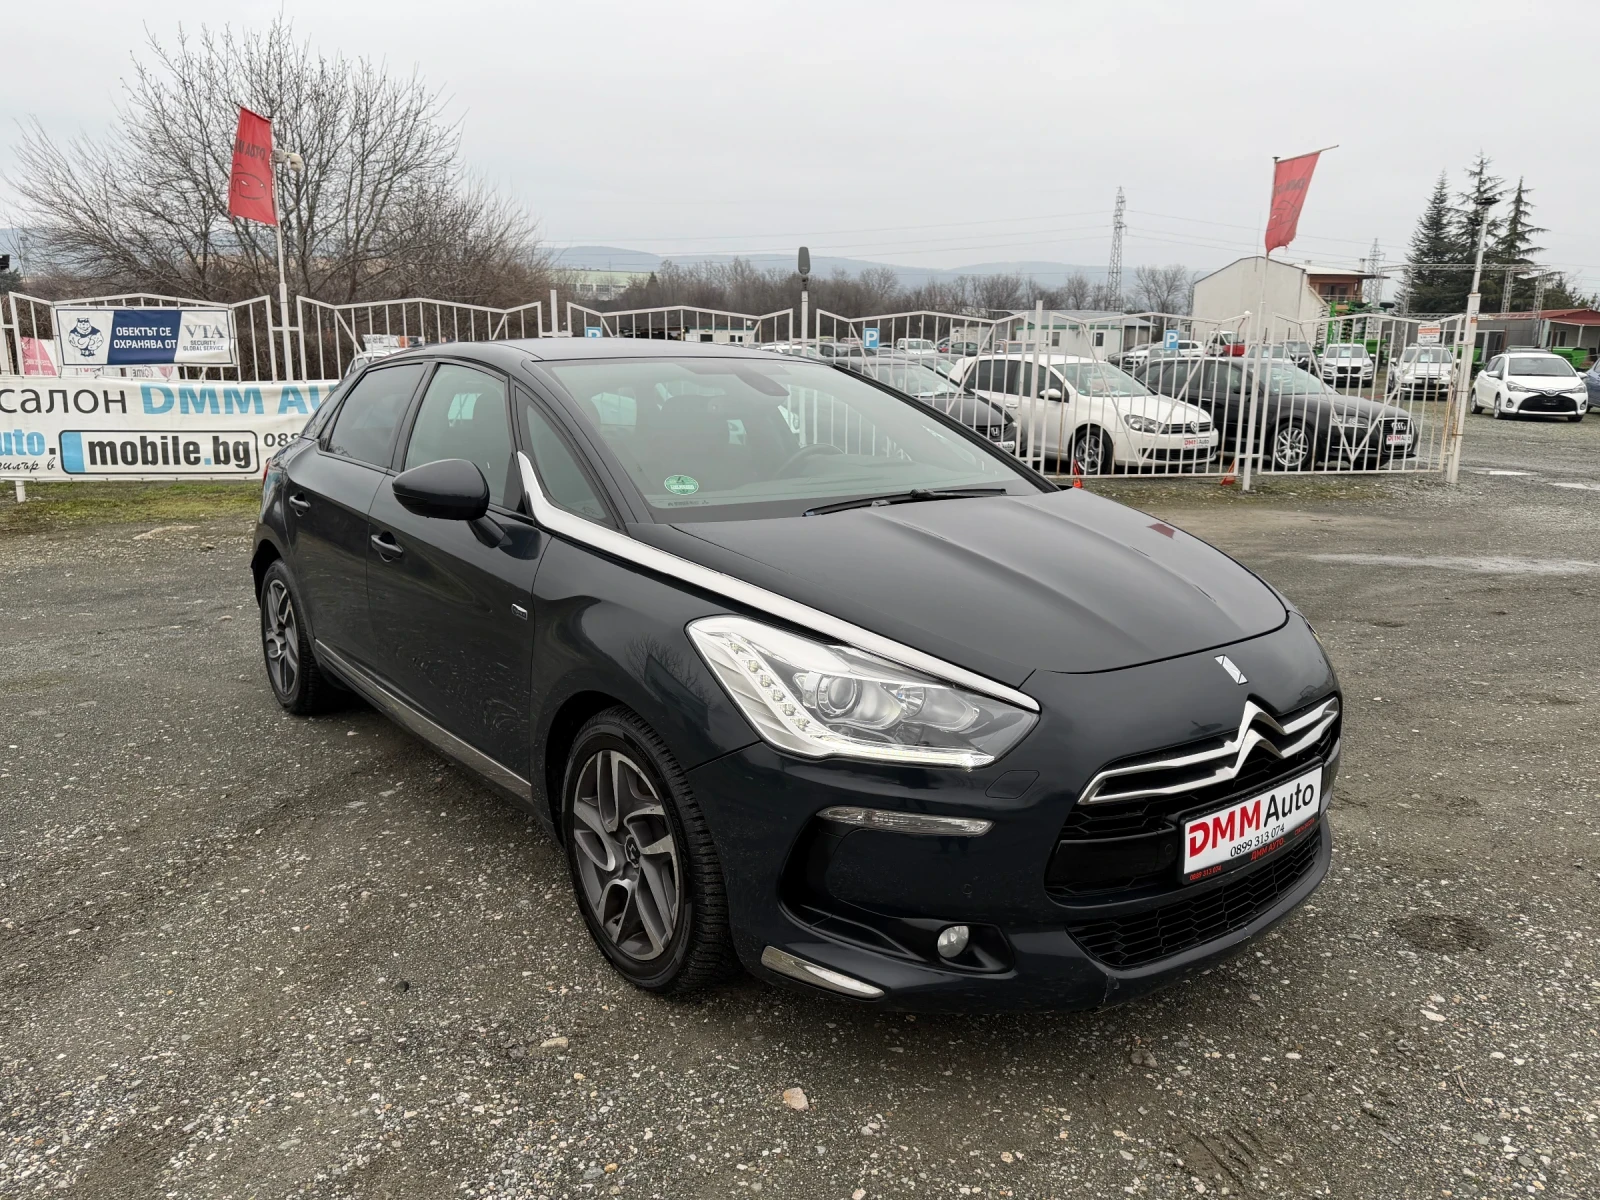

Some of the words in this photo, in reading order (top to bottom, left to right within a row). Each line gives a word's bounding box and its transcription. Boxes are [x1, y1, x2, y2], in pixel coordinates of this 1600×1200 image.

[116, 327, 158, 336] ОБЕКТЪТ
[159, 327, 172, 336] СЕ
[184, 324, 226, 339] VTA
[865, 330, 878, 347] P
[1165, 332, 1178, 348] P
[113, 339, 164, 349] ОХРАНЯВА
[165, 339, 176, 349] ОТ
[0, 388, 127, 414] салон
[140, 382, 265, 415] DMM
[88, 436, 251, 469] mobile.bg
[1189, 799, 1261, 858] DMM
[1263, 783, 1315, 828] Auto
[1230, 840, 1253, 857] 0899
[1254, 831, 1270, 845] 313
[1271, 823, 1285, 837] 074
